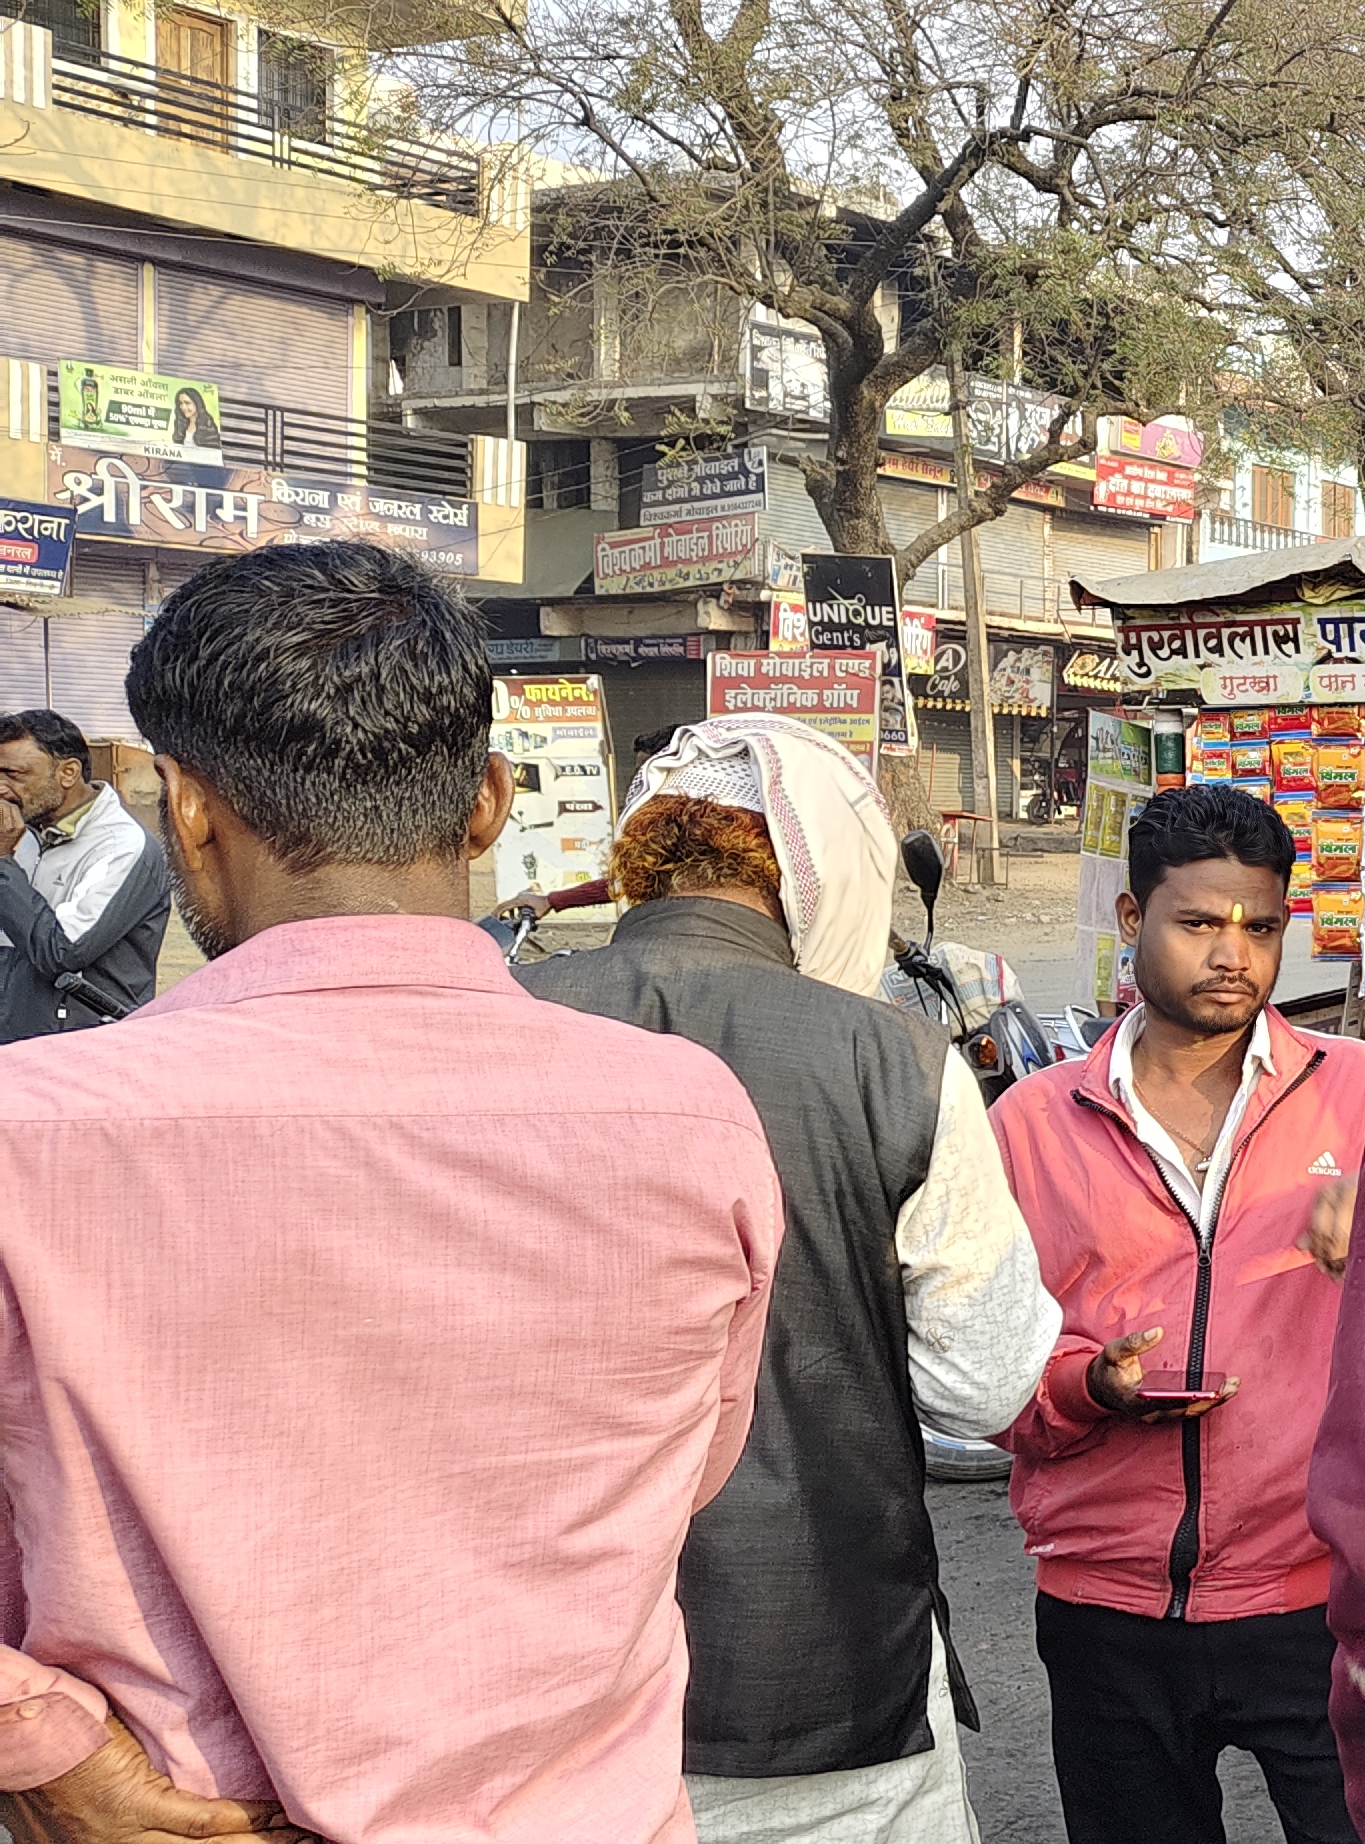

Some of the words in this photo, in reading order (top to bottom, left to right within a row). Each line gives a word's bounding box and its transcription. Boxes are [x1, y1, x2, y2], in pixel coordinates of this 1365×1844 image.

[143, 445, 183, 459] KIRANA
[723, 474, 746, 492] जाते
[54, 457, 265, 538] श्रीराम
[271, 478, 330, 509] किराना
[337, 492, 362, 512] एवं
[369, 497, 422, 520] जनरल
[428, 501, 469, 527] स्टोर्स
[303, 512, 332, 528] बस
[597, 529, 661, 578] विश्वकर्मा
[663, 524, 710, 562] मोबाईल
[712, 519, 751, 555] रिपेरिंग
[807, 602, 894, 626] UNIQUE
[811, 625, 861, 646] Gent's
[715, 653, 757, 678] शिवा
[760, 651, 830, 680] मोबाईल
[834, 658, 872, 678] एण्ड
[935, 653, 954, 671] A
[926, 674, 960, 696] Cafe
[1219, 671, 1280, 698] गुटखा
[1318, 671, 1355, 694] पान
[725, 684, 819, 711] इलेक्ट्रॉनिक
[823, 684, 860, 709] शॉप
[561, 765, 584, 776] .E.D.
[586, 765, 598, 775] TV
[1319, 768, 1358, 782] विमल
[1318, 841, 1358, 854] विमल
[1319, 914, 1358, 927] विमल
